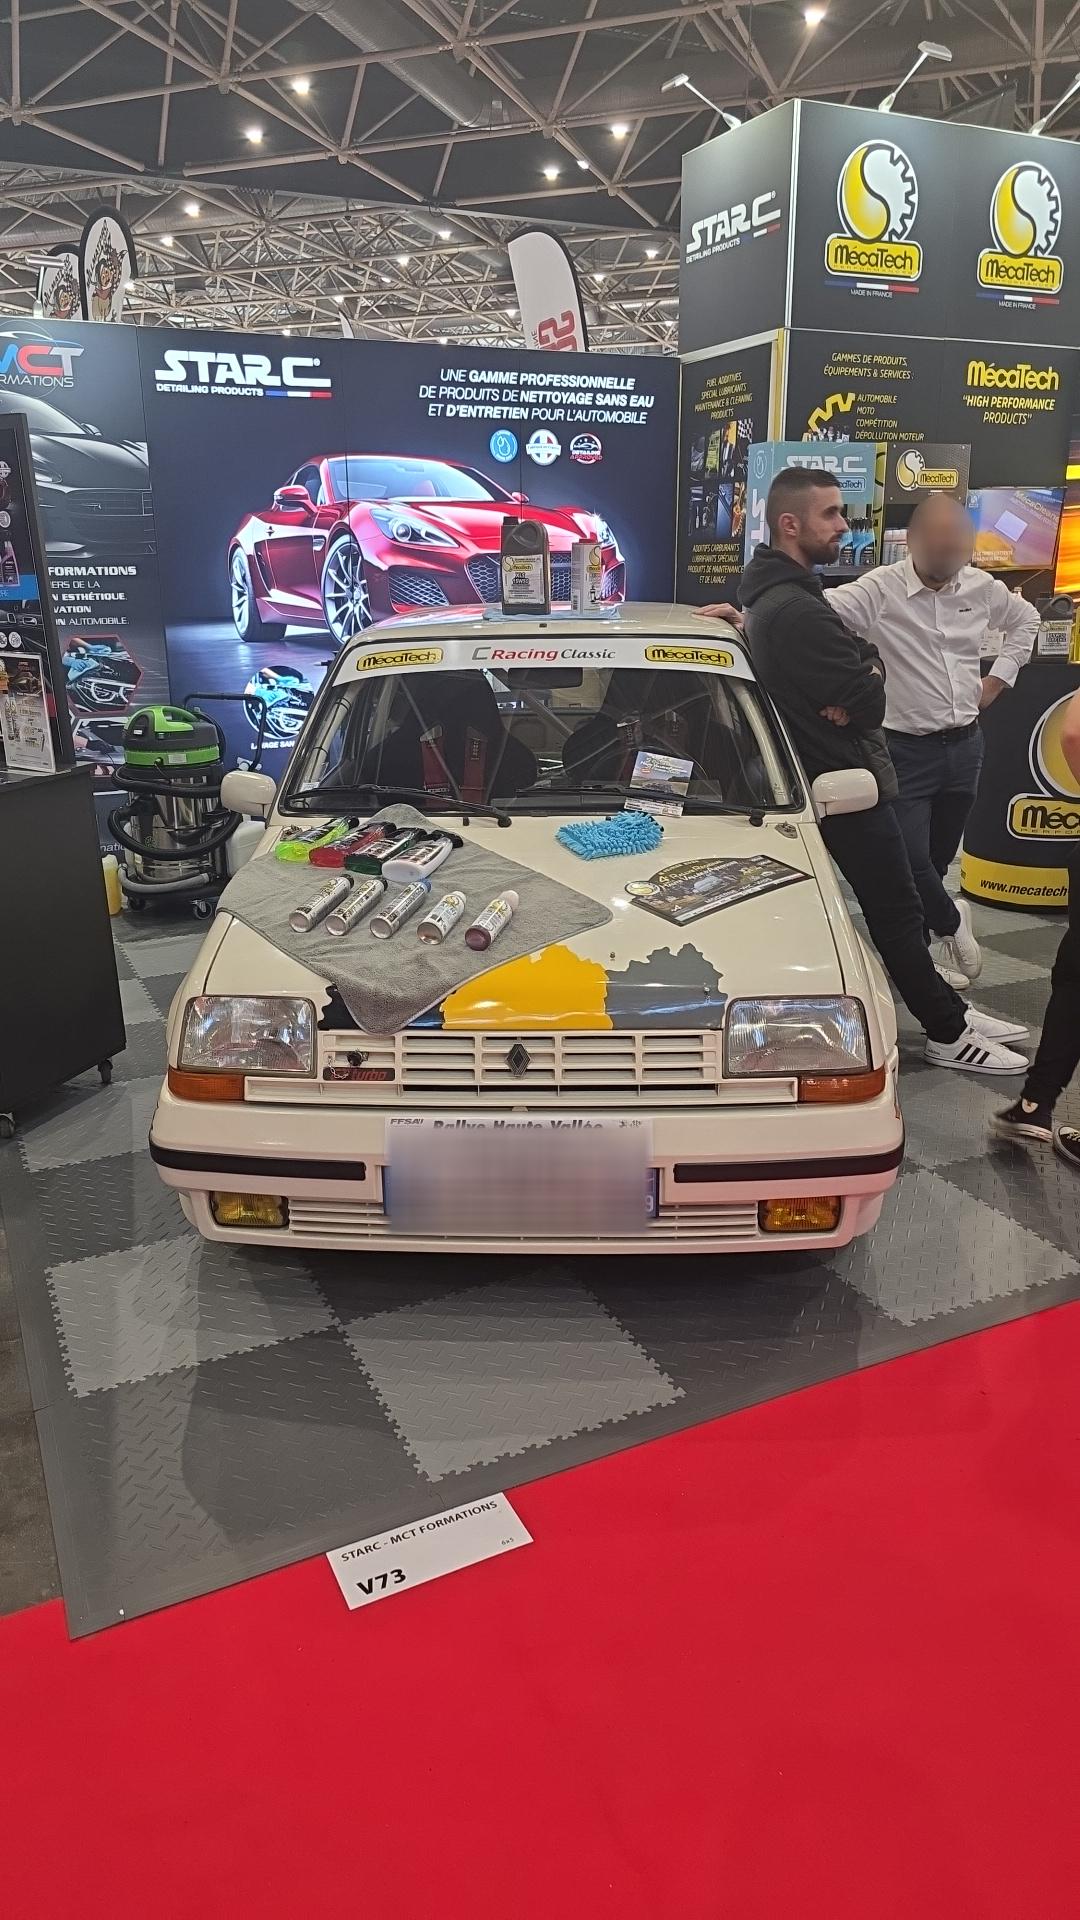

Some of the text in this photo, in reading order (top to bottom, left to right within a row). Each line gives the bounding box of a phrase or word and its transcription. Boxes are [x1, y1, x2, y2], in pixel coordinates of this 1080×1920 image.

[686, 237, 740, 264] DETAILING PRODUCTS
[834, 244, 913, 270] MécaTech
[985, 259, 1055, 284] MécaTech
[832, 352, 861, 363] GAMMES
[862, 354, 872, 364] DE
[823, 364, 872, 377] ÉQUIPEMENTS
[872, 368, 878, 377] &
[966, 360, 1059, 390] MécaTech
[440, 368, 635, 390] UNE GAMME PROFESSIONNELLE
[706, 371, 742, 388] FUEL ADDITIVES
[156, 383, 264, 397] DETAILING PRODUCTS
[419, 385, 655, 408] DE PRODUITS DE NETTOYAGE SANS EAU
[857, 393, 898, 404] AUTOMOBILE
[990, 396, 1056, 411] PERFORMANCE
[428, 403, 648, 424] ET D'ENTRETIEN POUR L'AUTOMOBILE
[710, 408, 734, 420] PRODUCTS
[856, 406, 875, 415] MOTO
[855, 418, 898, 428] COMPÉTITION
[855, 430, 925, 441] DÉPOLLUTION MOTEUR
[48, 566, 137, 576] FORMATIONS
[706, 565, 712, 573] DE
[50, 580, 101, 589] ERS DE LA
[560, 648, 616, 659] Classic
[1021, 805, 1080, 830] Méc
[980, 880, 1068, 896] www.mecatech
[341, 1541, 381, 1562] STARC
[390, 1529, 416, 1544] MCT
[419, 1500, 498, 1534] FORMATIONS
[356, 1568, 407, 1595] V73
